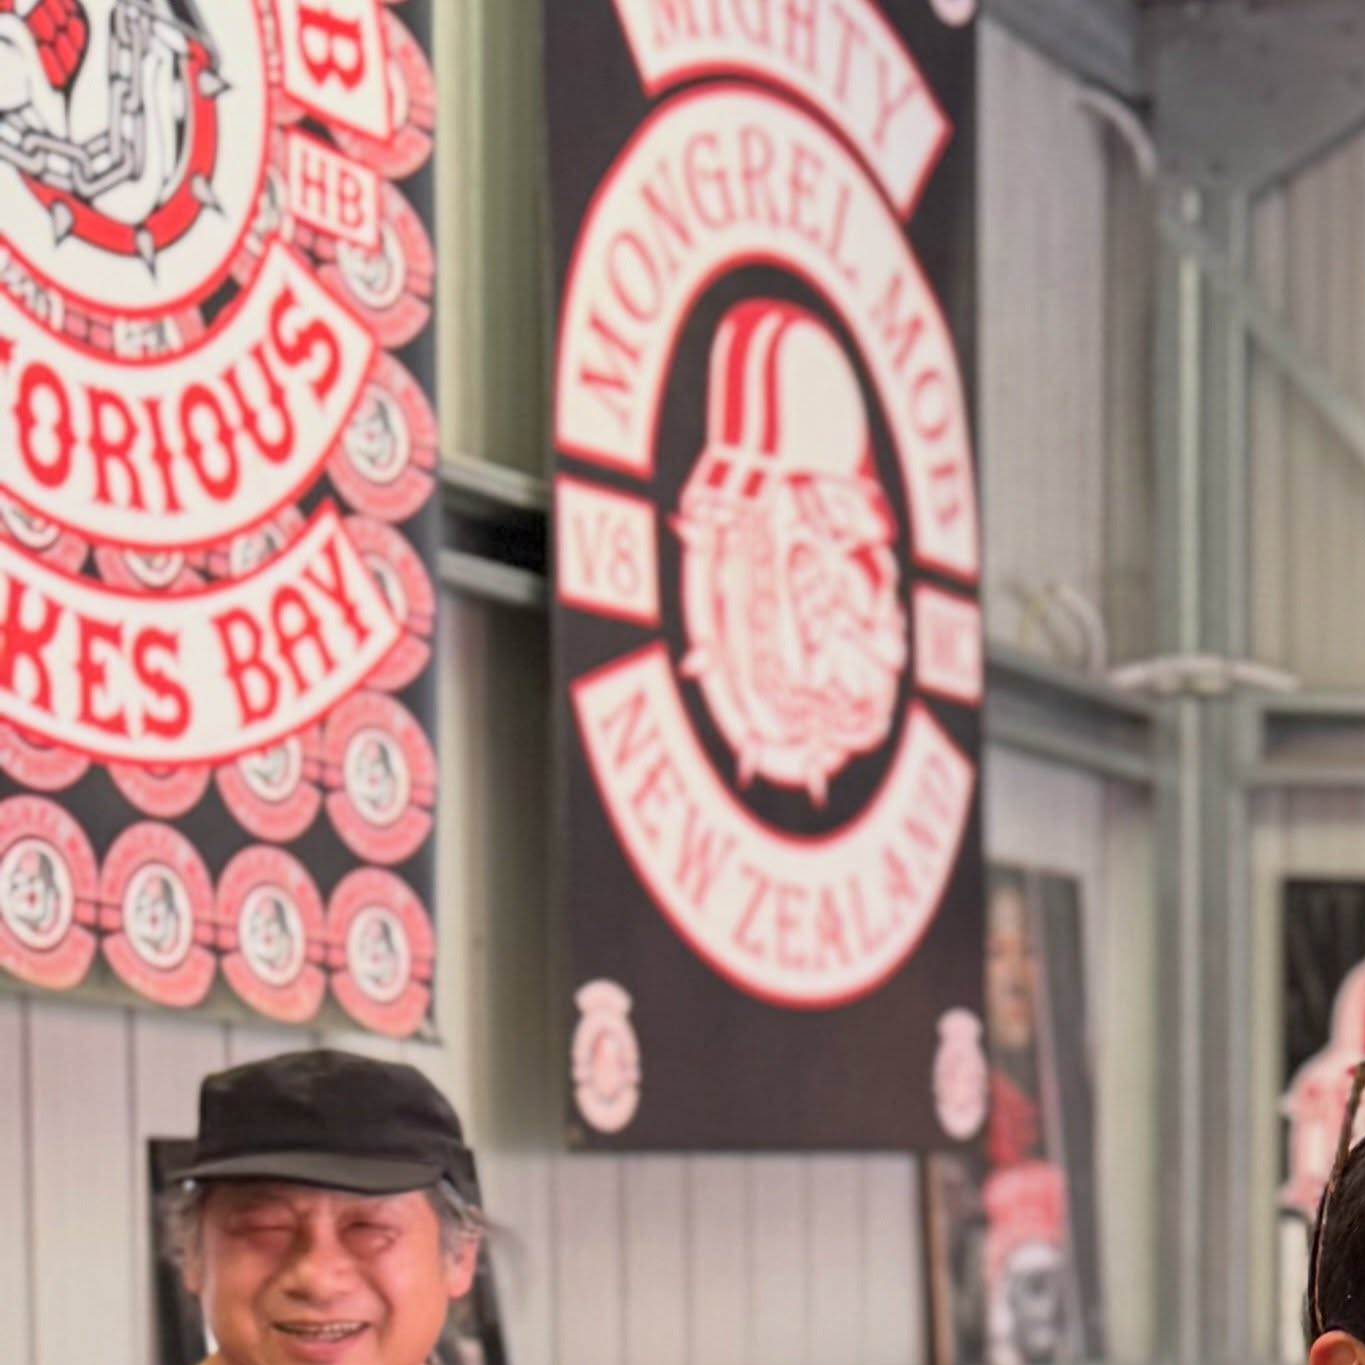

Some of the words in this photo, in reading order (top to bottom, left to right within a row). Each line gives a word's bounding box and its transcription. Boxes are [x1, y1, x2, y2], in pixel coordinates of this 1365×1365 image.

[299, 150, 366, 231] HB
[0, 284, 343, 515] ORIOUS
[580, 124, 861, 430] MONGREL
[870, 272, 963, 535] MOB
[212, 541, 375, 723] BAY
[599, 690, 736, 911] NEW
[731, 750, 955, 972] ZEALAND
